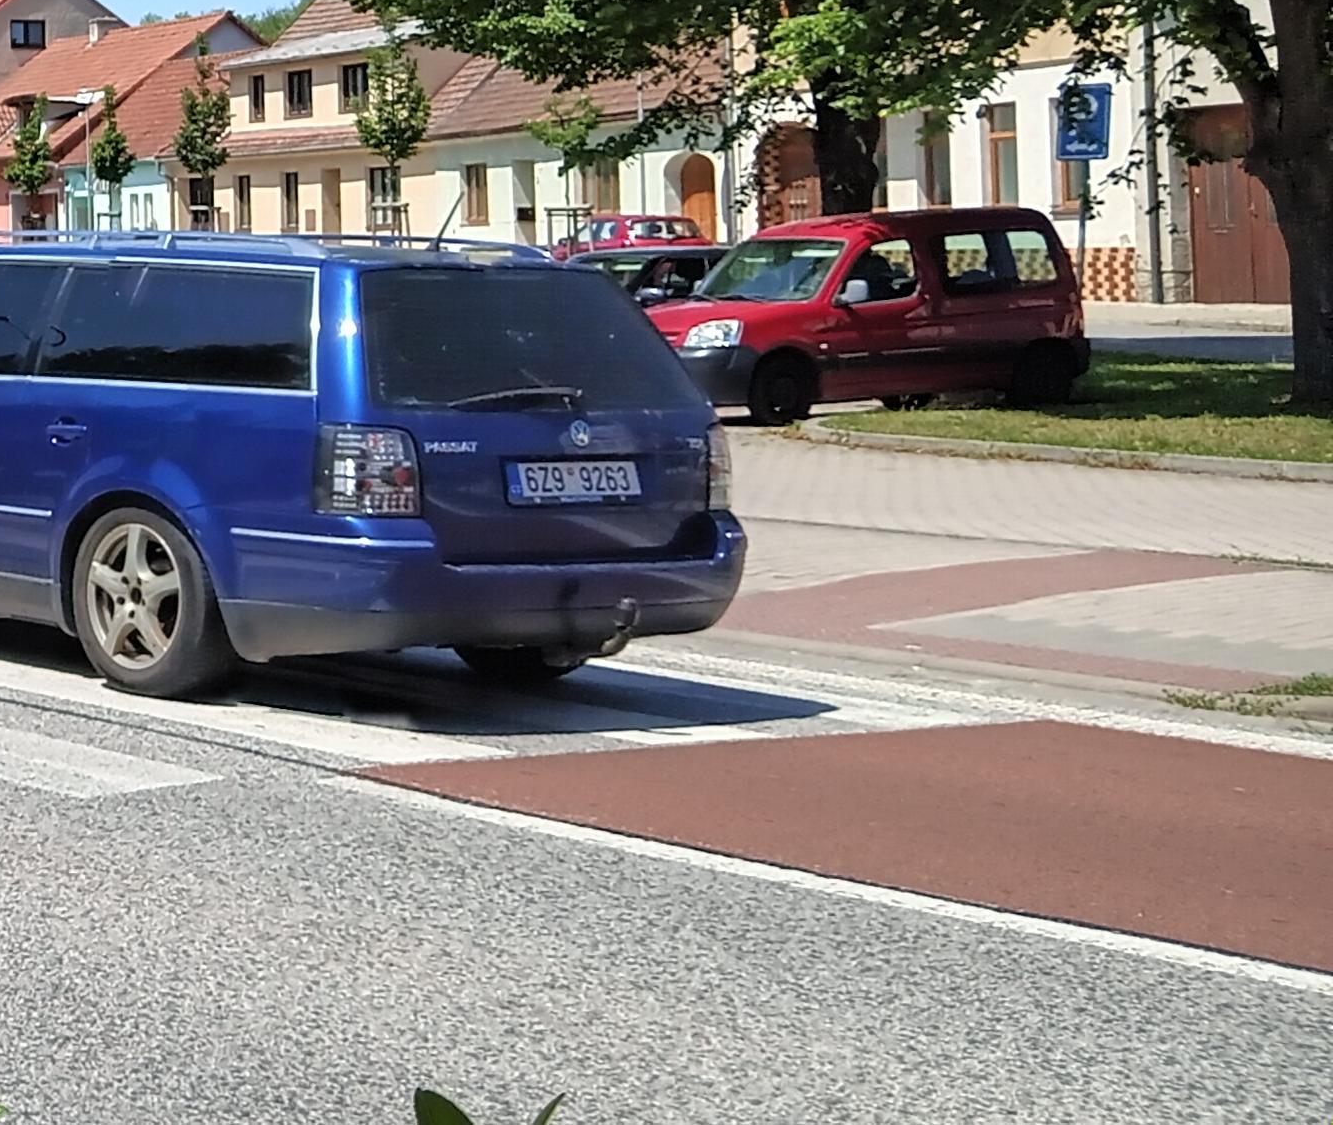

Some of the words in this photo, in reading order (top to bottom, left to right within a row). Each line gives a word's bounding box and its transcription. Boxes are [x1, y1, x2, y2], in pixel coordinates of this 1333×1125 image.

[424, 441, 478, 453] PASSAT
[524, 466, 566, 493] 6Z9
[578, 466, 631, 492] 9263
